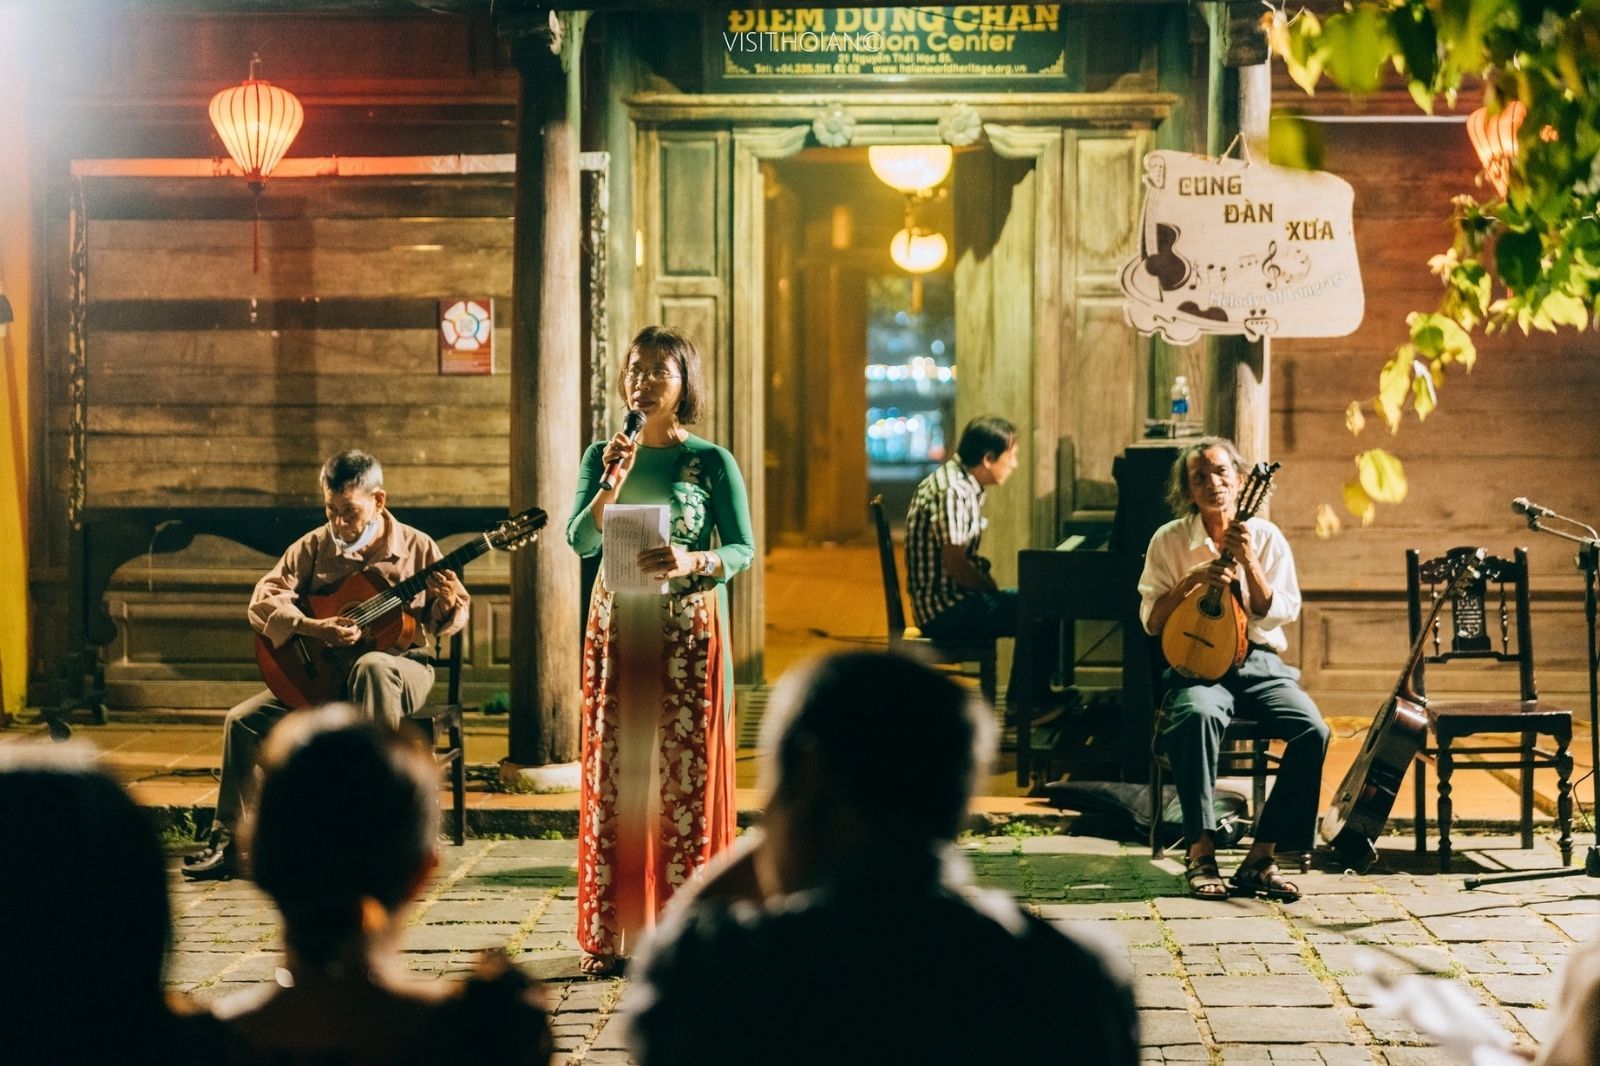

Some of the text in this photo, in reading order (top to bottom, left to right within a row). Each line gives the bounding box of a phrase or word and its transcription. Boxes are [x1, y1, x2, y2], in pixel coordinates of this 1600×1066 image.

[927, 31, 1015, 52] Center
[1224, 199, 1274, 224] ĐÀN
[1286, 218, 1335, 241] XƯA
[1208, 288, 1262, 308] Melody
